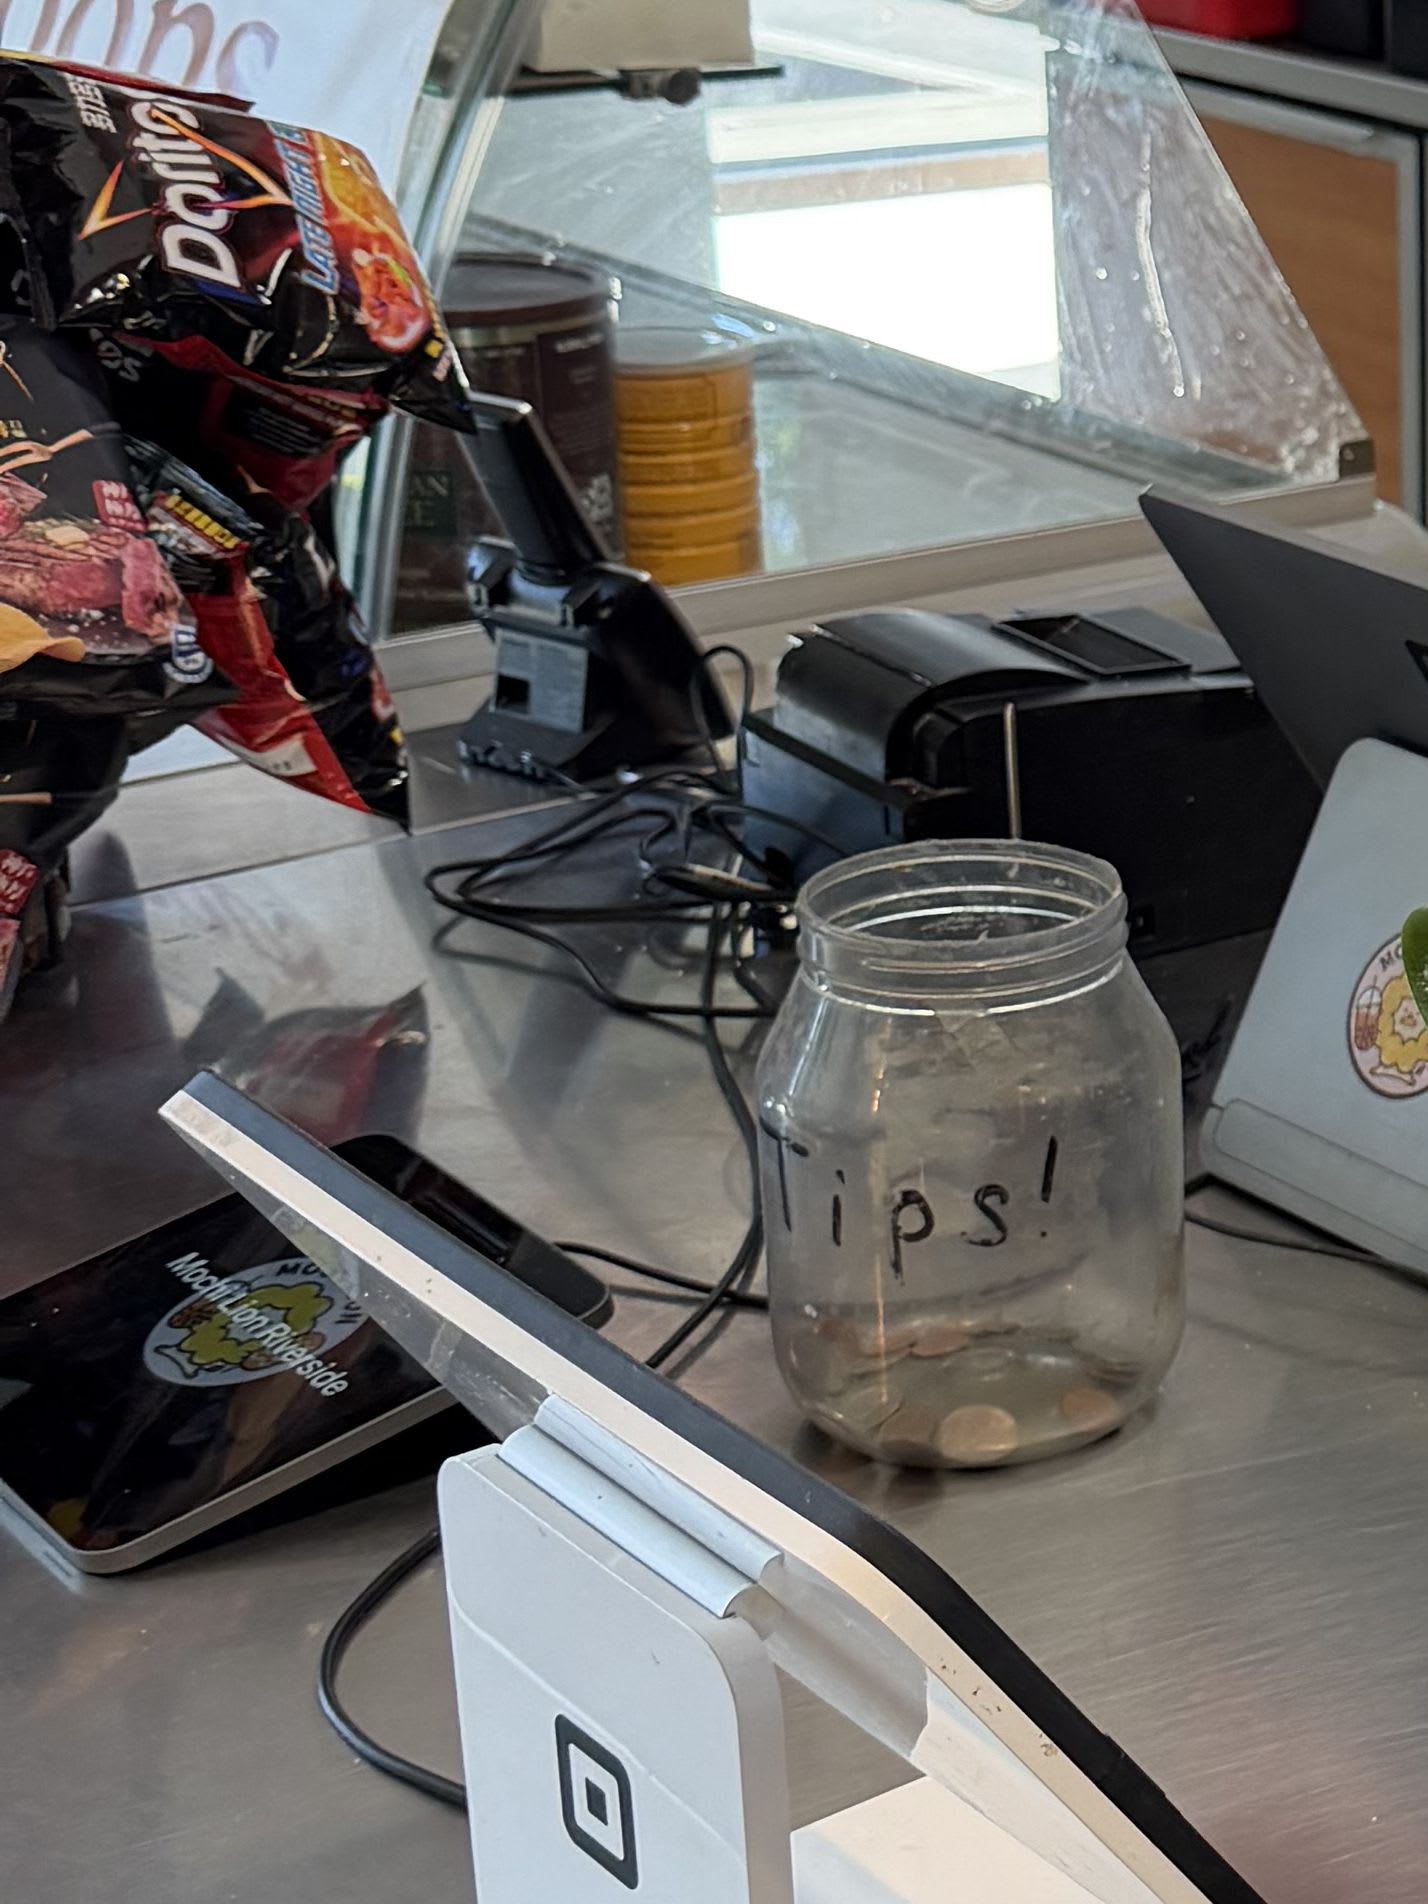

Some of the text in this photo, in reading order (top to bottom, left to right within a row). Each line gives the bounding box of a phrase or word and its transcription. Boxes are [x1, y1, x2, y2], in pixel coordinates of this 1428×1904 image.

[122, 86, 242, 290] Dorito
[298, 222, 340, 295] LATE
[759, 1116, 1058, 1286] Tips!
[165, 1251, 246, 1303] Mochi
[216, 1288, 271, 1339] Lion
[262, 1324, 349, 1397] Riverside
